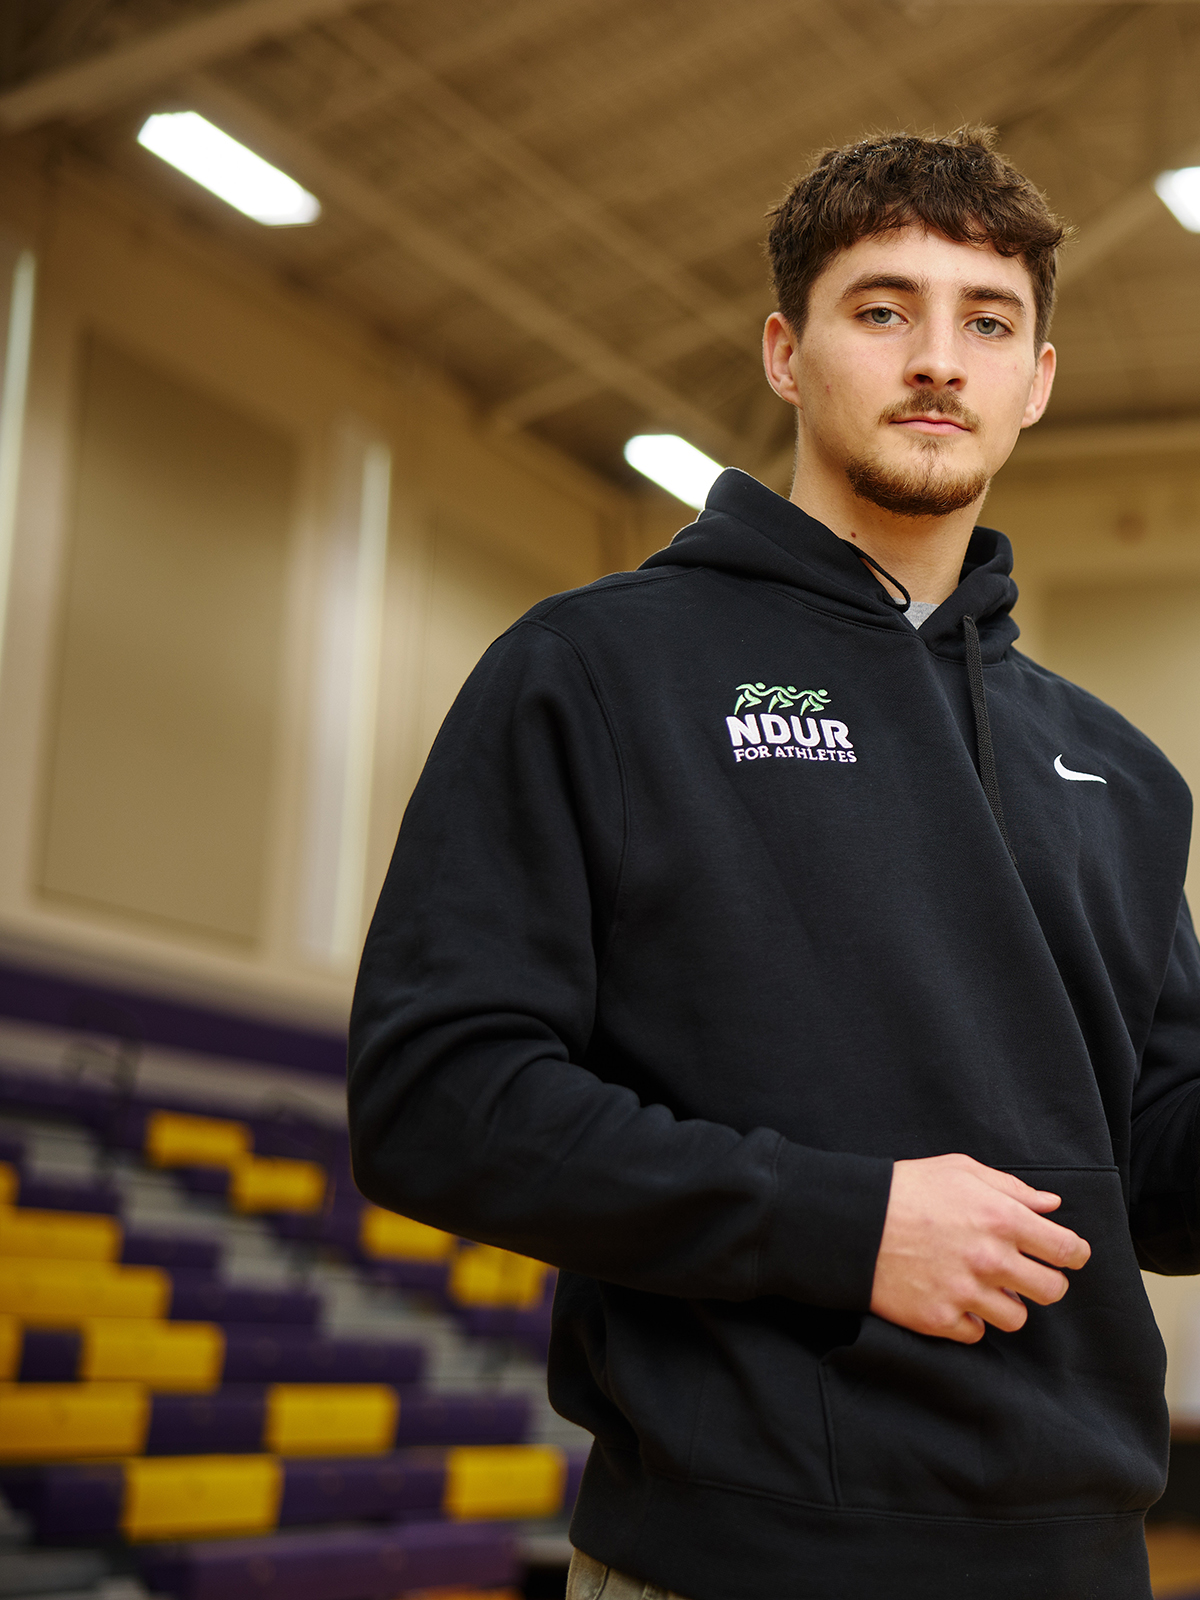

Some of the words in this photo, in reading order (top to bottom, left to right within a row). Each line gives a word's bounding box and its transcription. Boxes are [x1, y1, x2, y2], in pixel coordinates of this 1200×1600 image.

[726, 713, 854, 749] NDUR
[733, 745, 772, 762] FOR
[775, 745, 857, 763] ATHLETES
